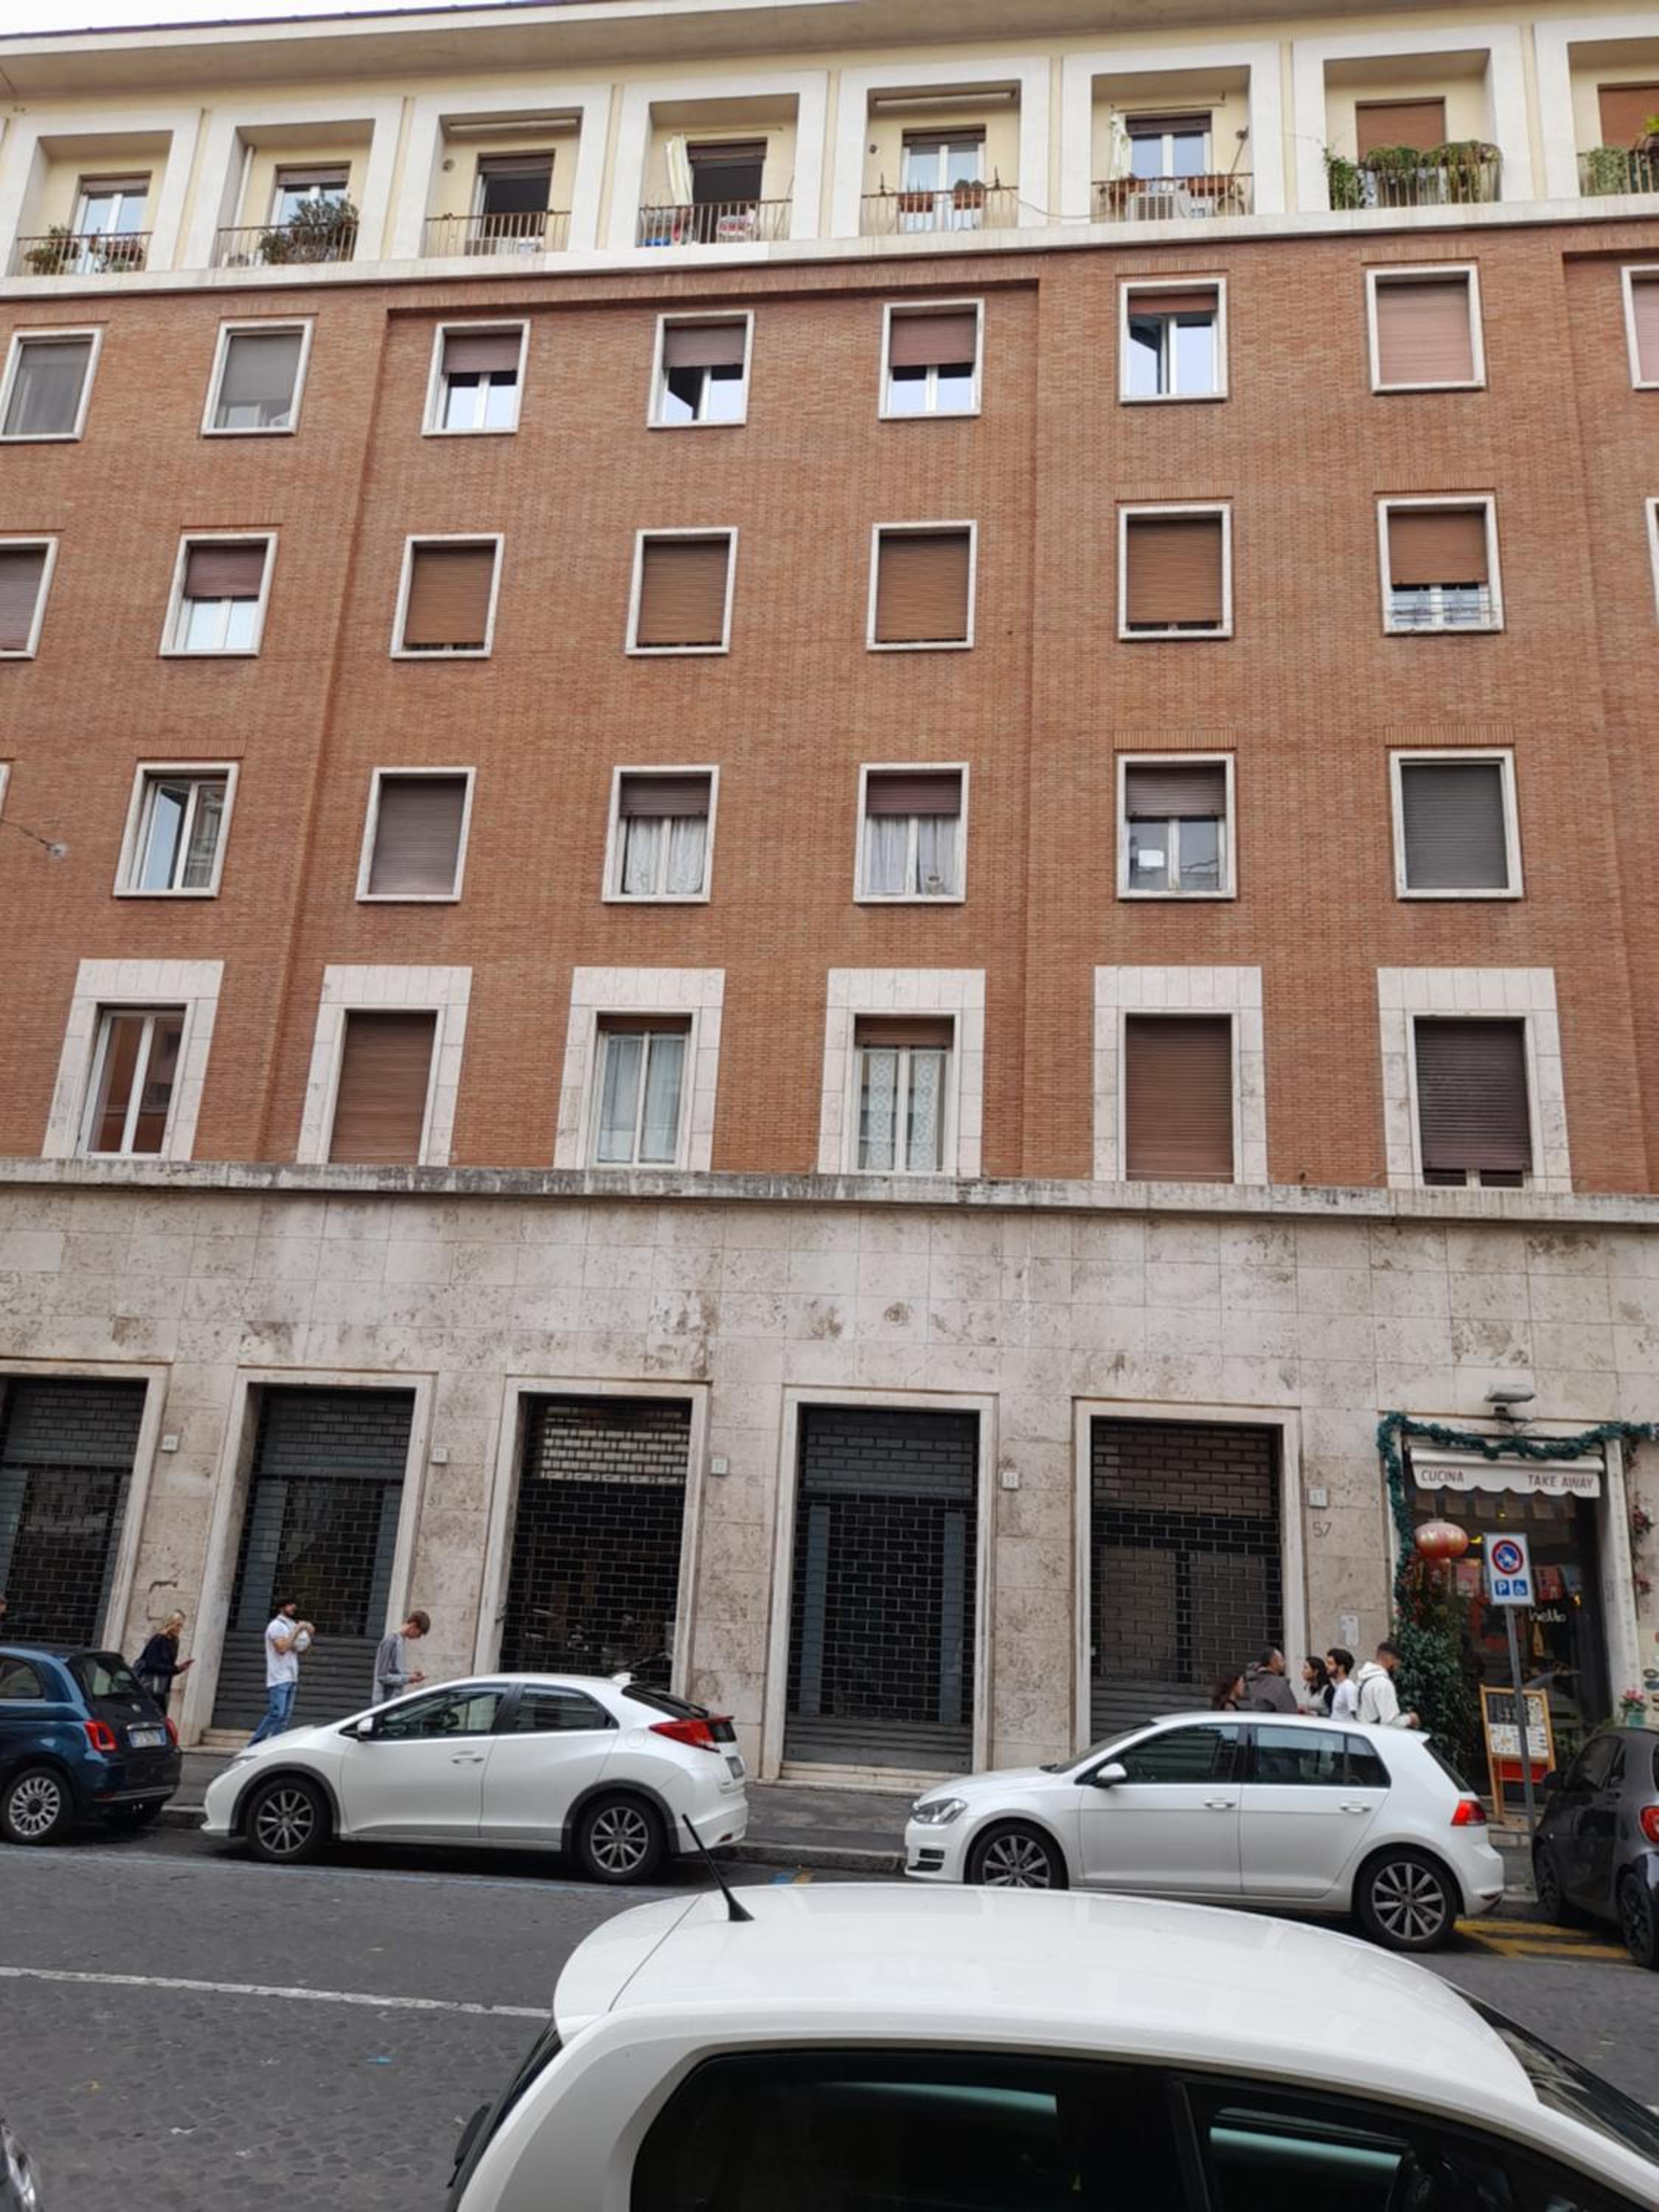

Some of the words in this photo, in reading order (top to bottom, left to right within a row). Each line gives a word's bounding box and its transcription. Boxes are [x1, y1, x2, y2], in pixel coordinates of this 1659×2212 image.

[1421, 1470, 1464, 1482] CUCINA
[1528, 1475, 1557, 1487] TAKE
[1561, 1476, 1594, 1489] AWAY
[1312, 1522, 1332, 1537] 57
